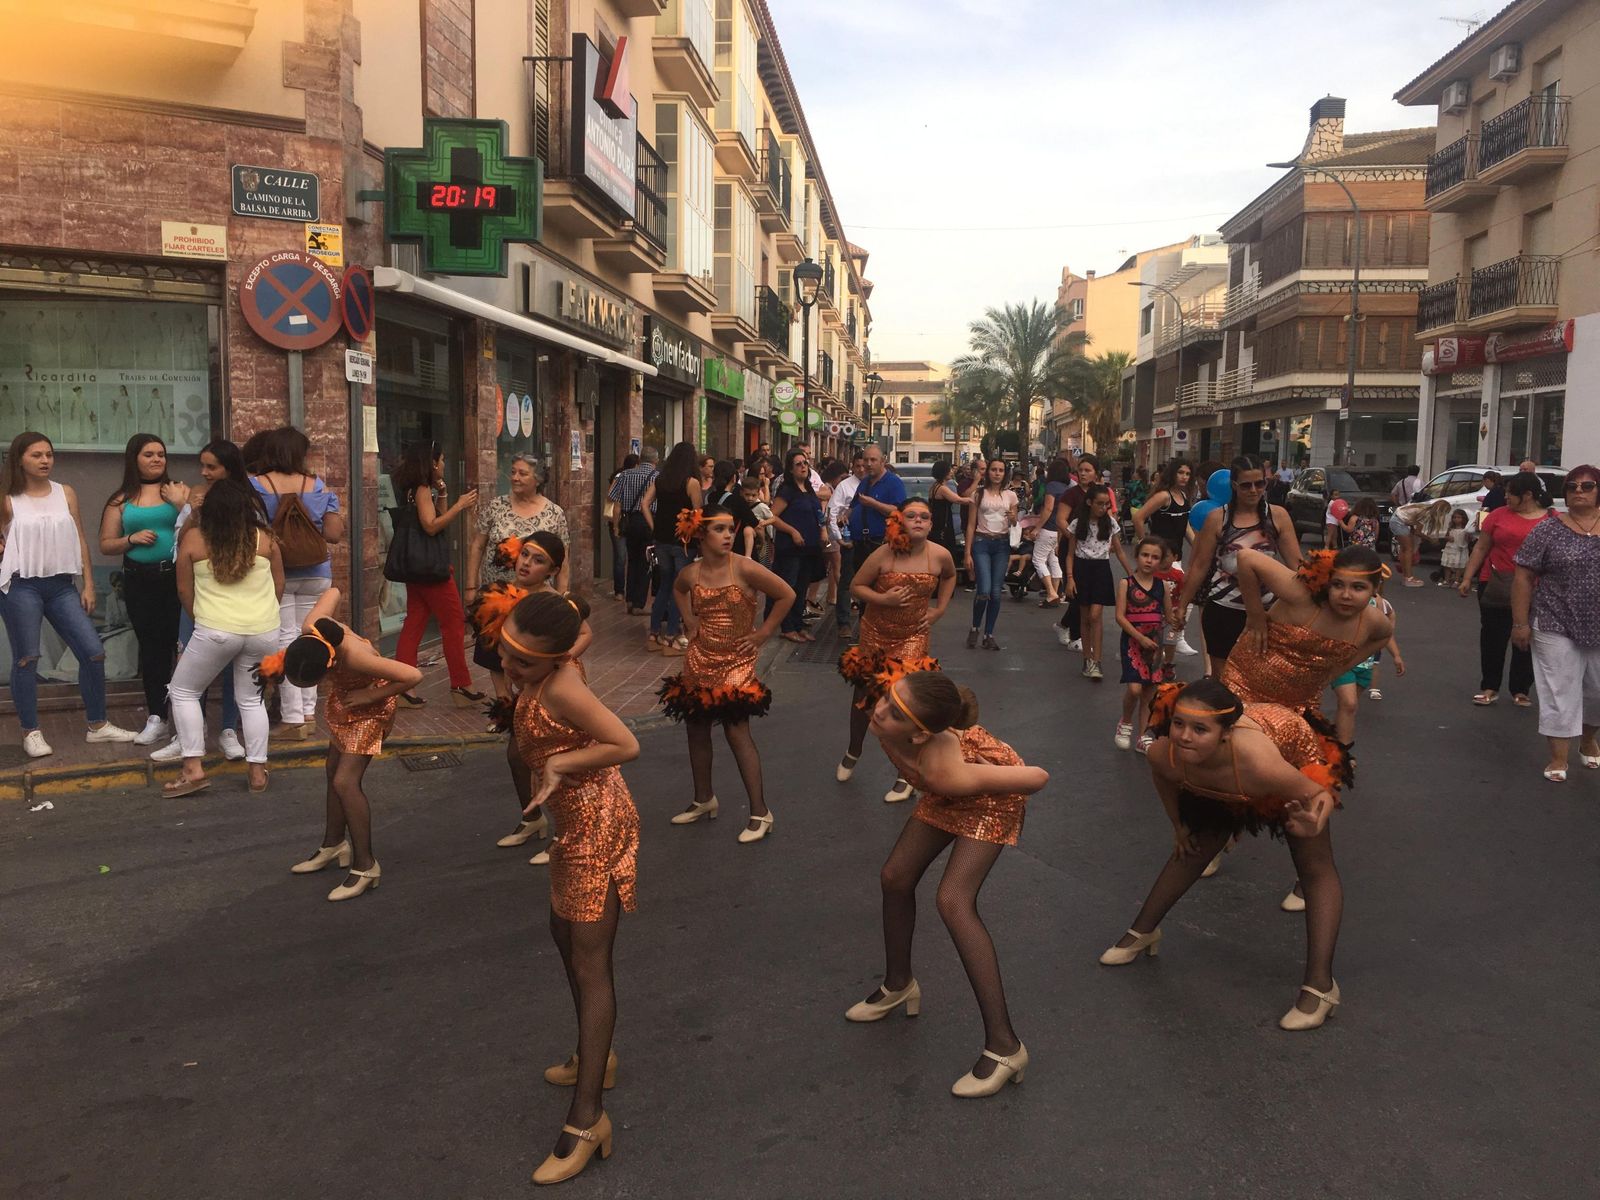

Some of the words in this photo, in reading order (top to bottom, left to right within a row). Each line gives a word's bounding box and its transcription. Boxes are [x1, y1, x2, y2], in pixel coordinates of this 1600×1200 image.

[586, 113, 616, 164] ANTONIO
[264, 174, 309, 190] CALLE
[246, 192, 280, 203] CAMINO
[282, 195, 293, 205] DE
[295, 197, 306, 206] LA
[431, 185, 496, 208] 20:19
[240, 203, 267, 214] BALSA
[268, 206, 280, 215] DE
[281, 208, 312, 218] ARRIBA
[164, 242, 185, 251] FIJAR
[186, 244, 225, 254] CARTELES
[173, 235, 215, 245] PROHIBIDO
[245, 259, 270, 290] EXCEPTO
[271, 252, 300, 262] CARGA
[305, 256, 310, 264] Y
[312, 261, 341, 300] DESCARGA
[24, 363, 97, 383] Ricardita
